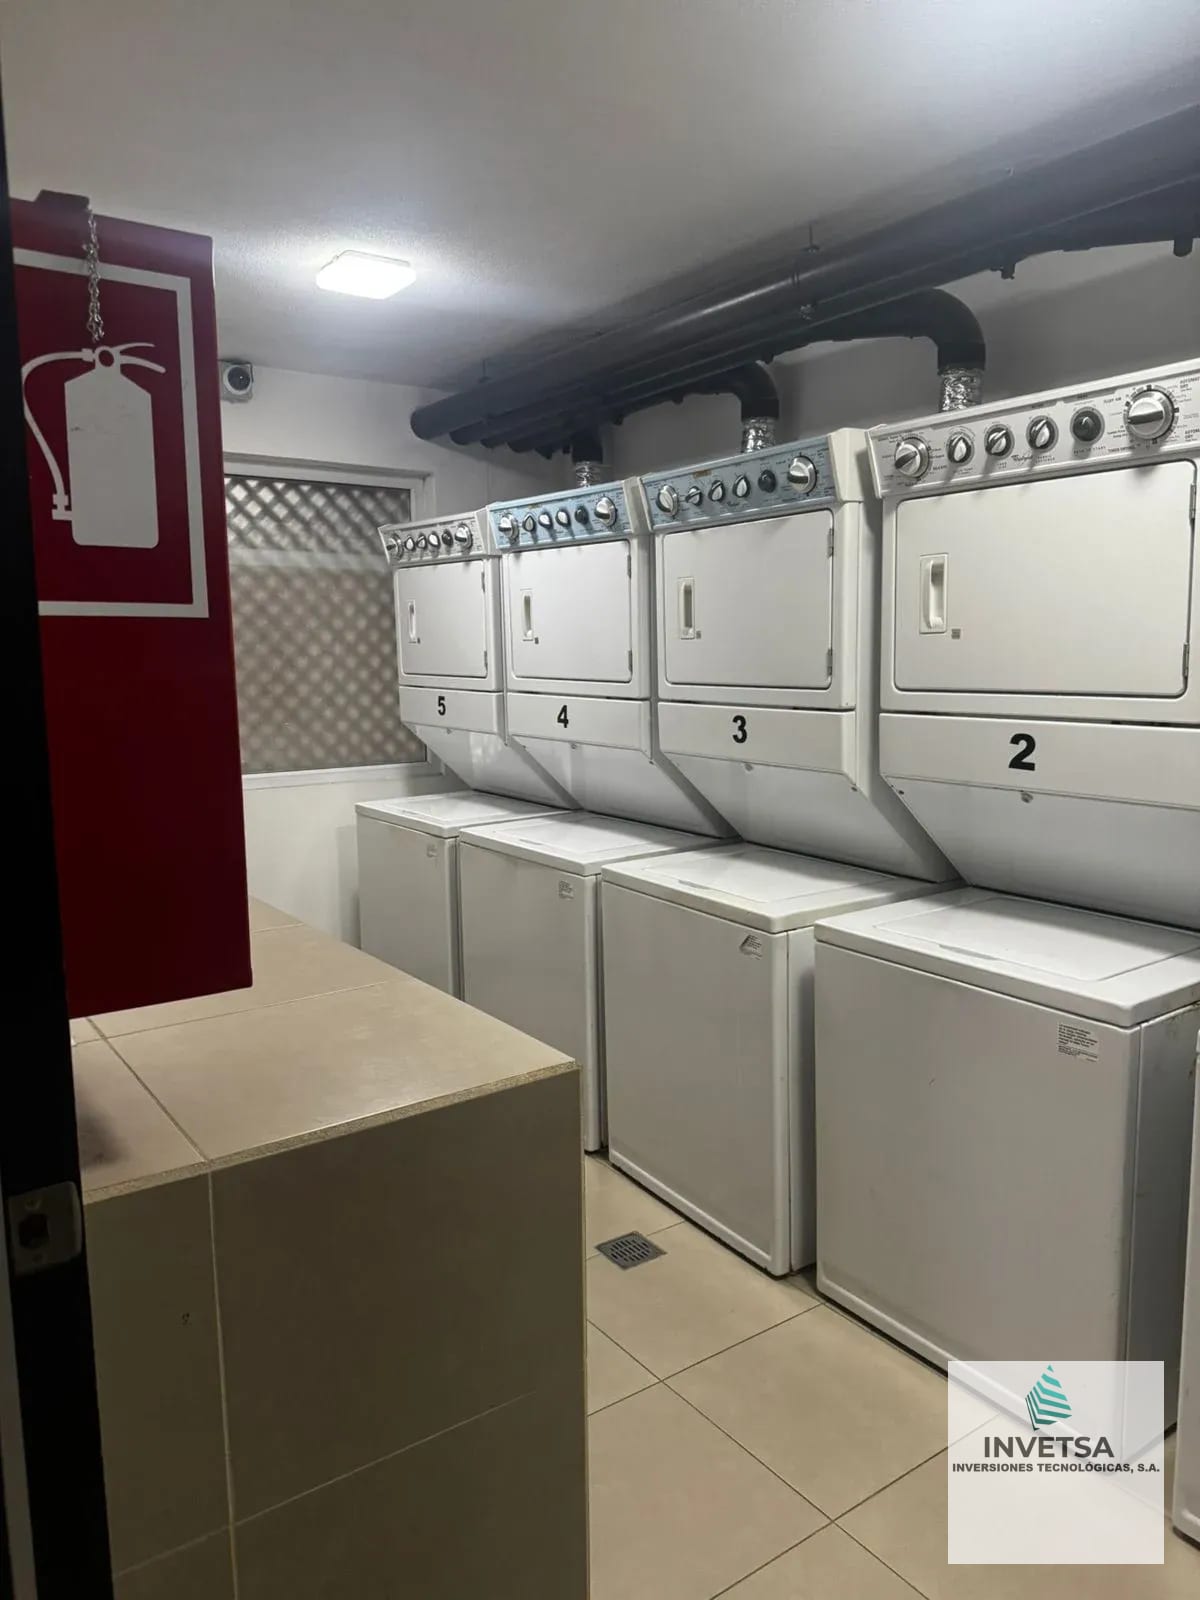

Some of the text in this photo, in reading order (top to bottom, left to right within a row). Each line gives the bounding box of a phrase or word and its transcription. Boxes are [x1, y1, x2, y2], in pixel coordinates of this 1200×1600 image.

[437, 696, 447, 716] 5
[556, 705, 569, 729] 4
[732, 715, 748, 744] 3
[1009, 732, 1036, 772] 2
